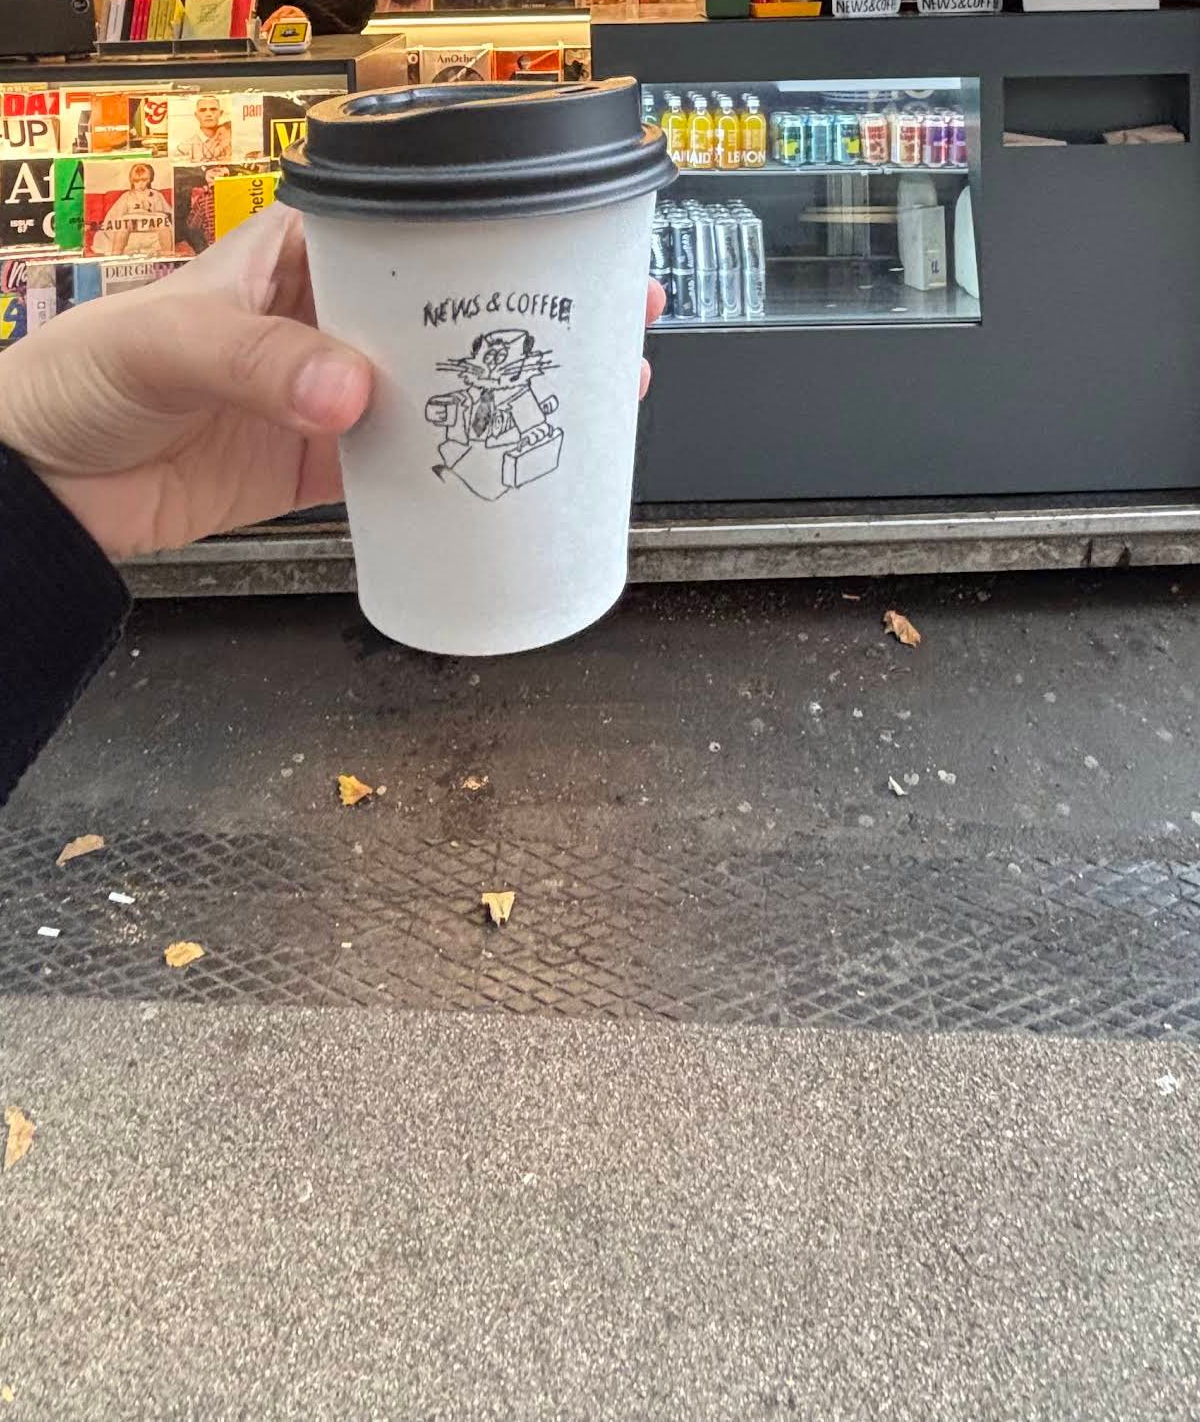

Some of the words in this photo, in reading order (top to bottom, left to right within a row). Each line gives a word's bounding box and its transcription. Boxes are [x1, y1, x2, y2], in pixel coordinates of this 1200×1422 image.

[91, 218, 138, 232] BEAUTY
[105, 265, 133, 279] DER
[423, 292, 481, 327] NEWS
[486, 291, 500, 313] &
[506, 291, 573, 324] COFFEE
